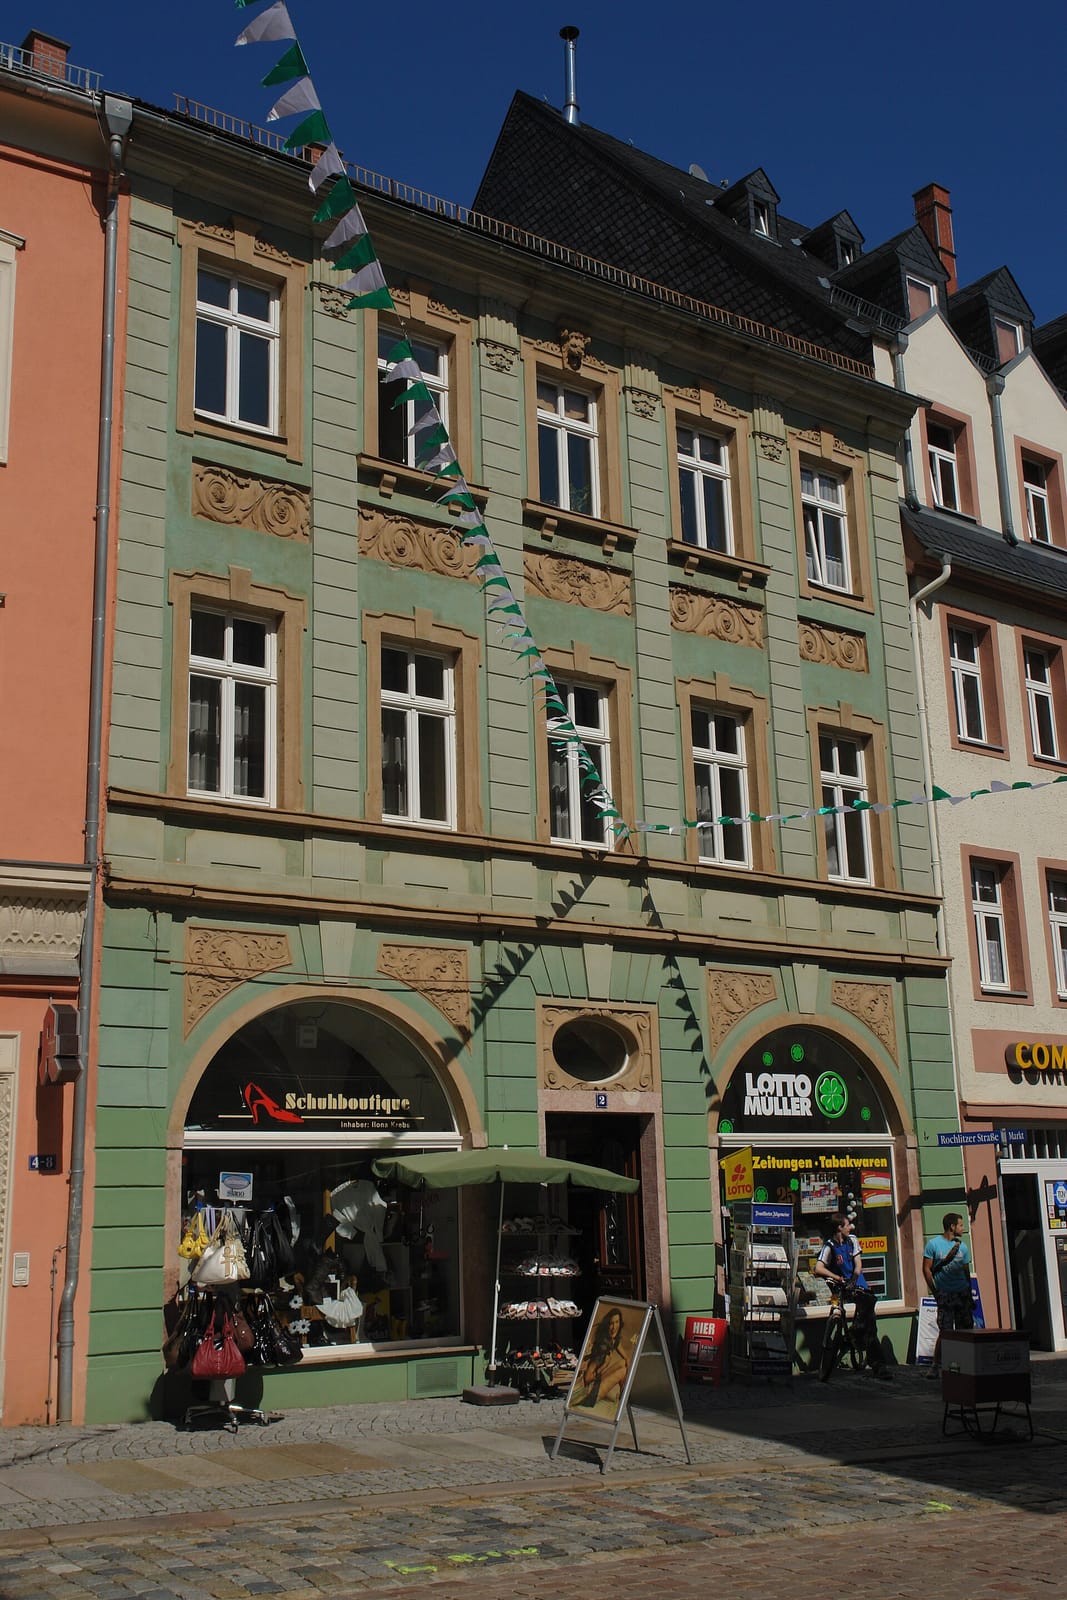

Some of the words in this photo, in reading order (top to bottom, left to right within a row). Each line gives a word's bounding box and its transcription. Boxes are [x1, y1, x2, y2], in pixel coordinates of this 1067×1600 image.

[745, 1072, 812, 1097] LOTTO
[285, 1092, 410, 1115] Schuhboutique
[598, 1095, 606, 1105] 2
[744, 1093, 813, 1117] MÜLLER
[340, 1120, 370, 1129] Inhaber:
[371, 1120, 389, 1129] Ilona
[390, 1120, 410, 1129] Krebs
[940, 1133, 976, 1145] Rochlitzer
[977, 1132, 999, 1143] Straße
[1008, 1131, 1025, 1141] Markt
[31, 1156, 54, 1169] 4-8
[752, 1155, 812, 1172] Zeitungen
[819, 1154, 888, 1168] Tabakwaren
[727, 1183, 753, 1196] LOTTO
[865, 1239, 885, 1249] LOTTO
[693, 1321, 715, 1335] HIER
